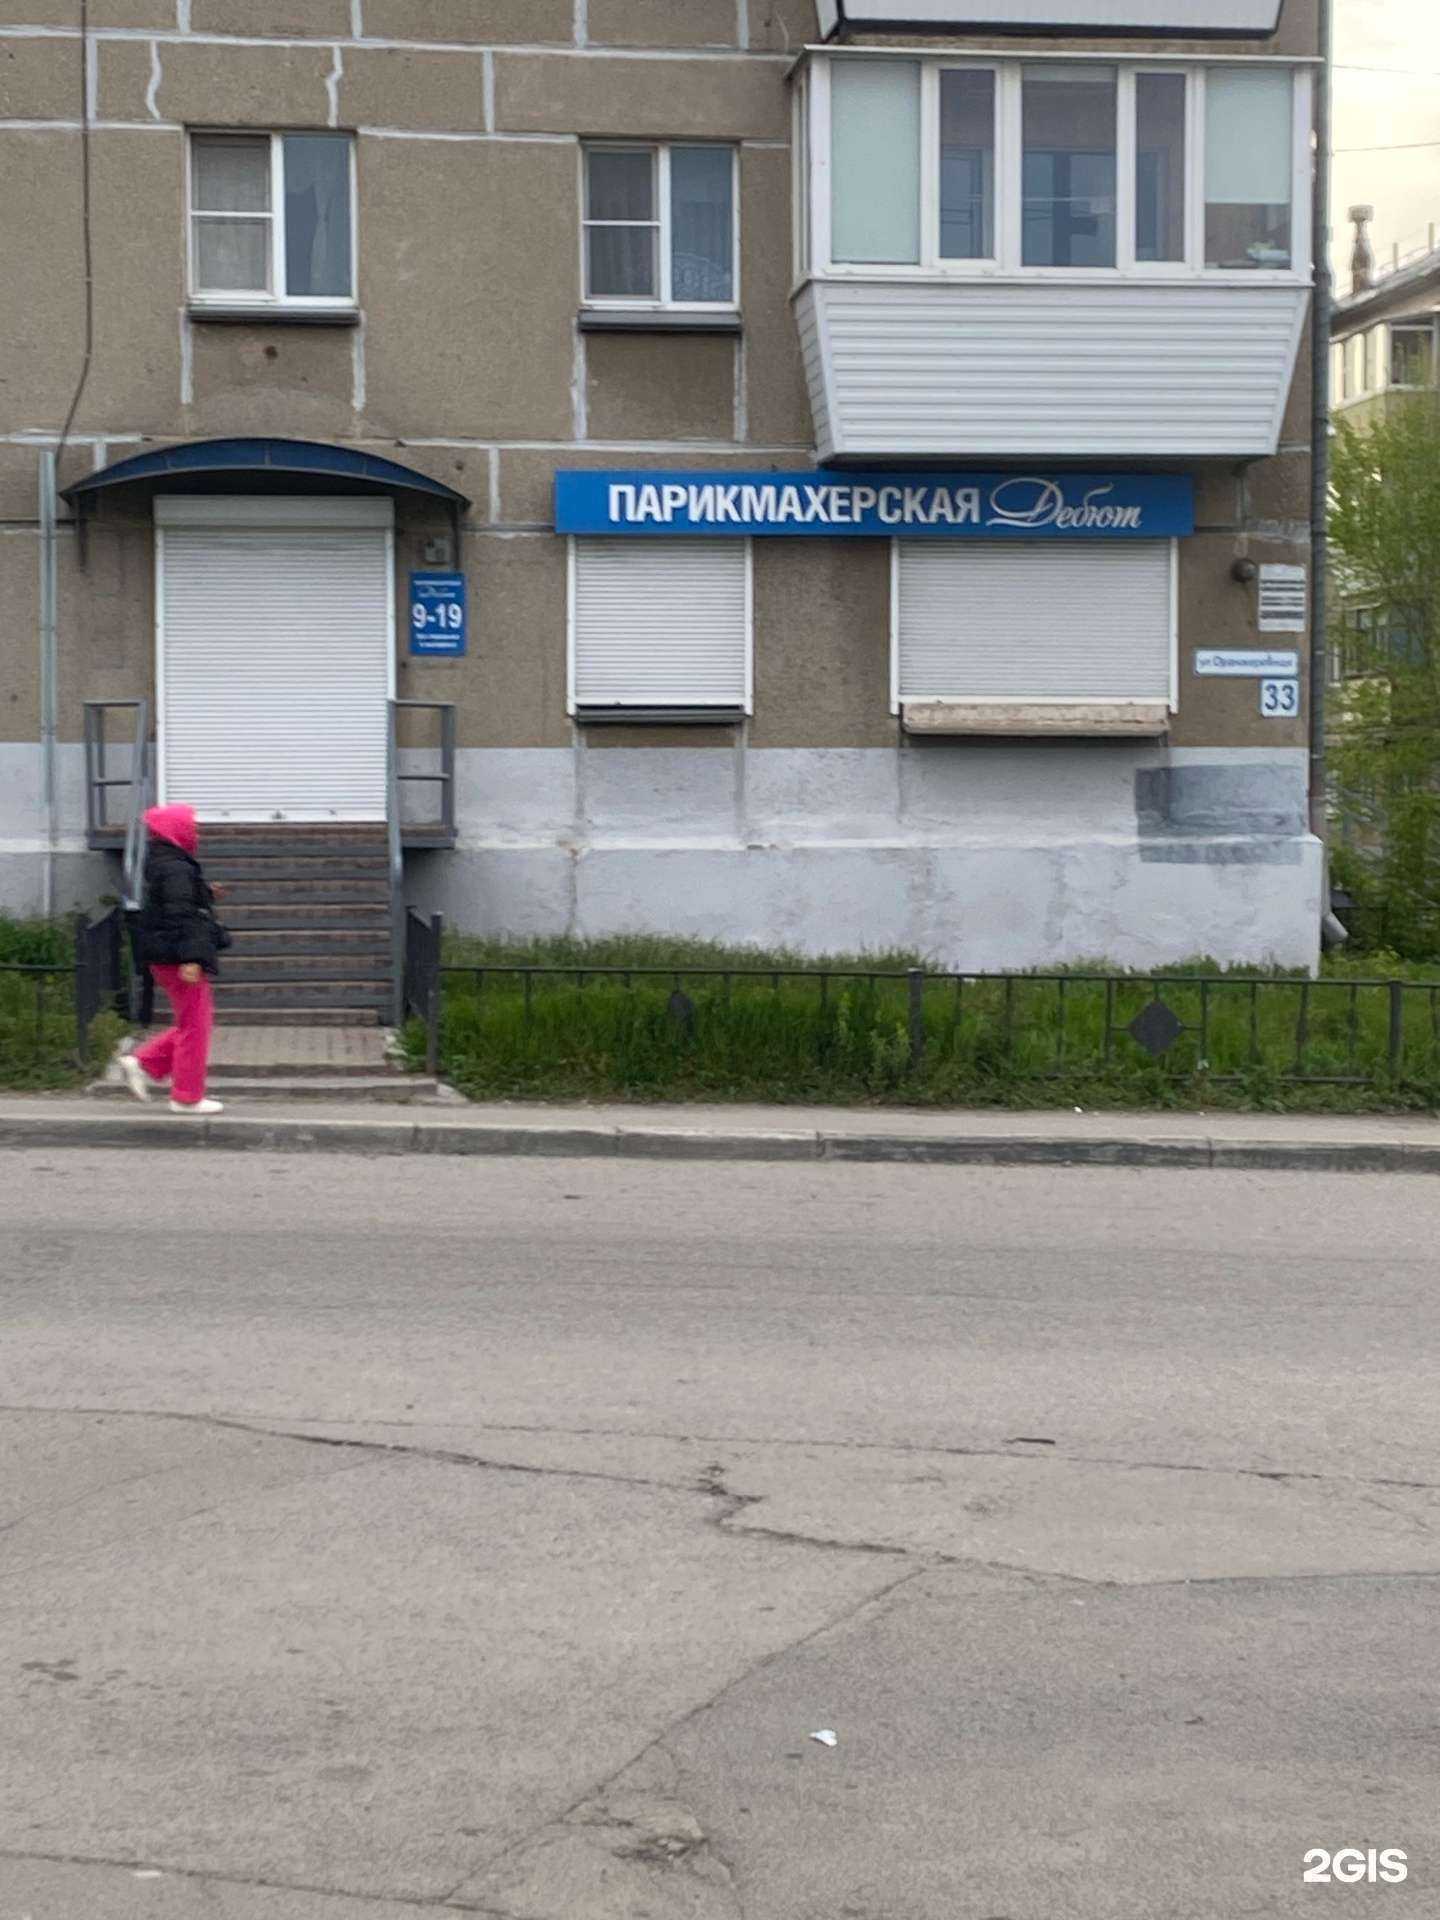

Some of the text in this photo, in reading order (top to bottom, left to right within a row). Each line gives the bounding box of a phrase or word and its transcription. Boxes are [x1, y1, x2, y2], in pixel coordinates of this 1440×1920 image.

[609, 477, 1142, 528] ПАРИКМАХЕРСКАЯ Дебют
[412, 603, 462, 628] 9-19
[1264, 684, 1295, 710] 33
